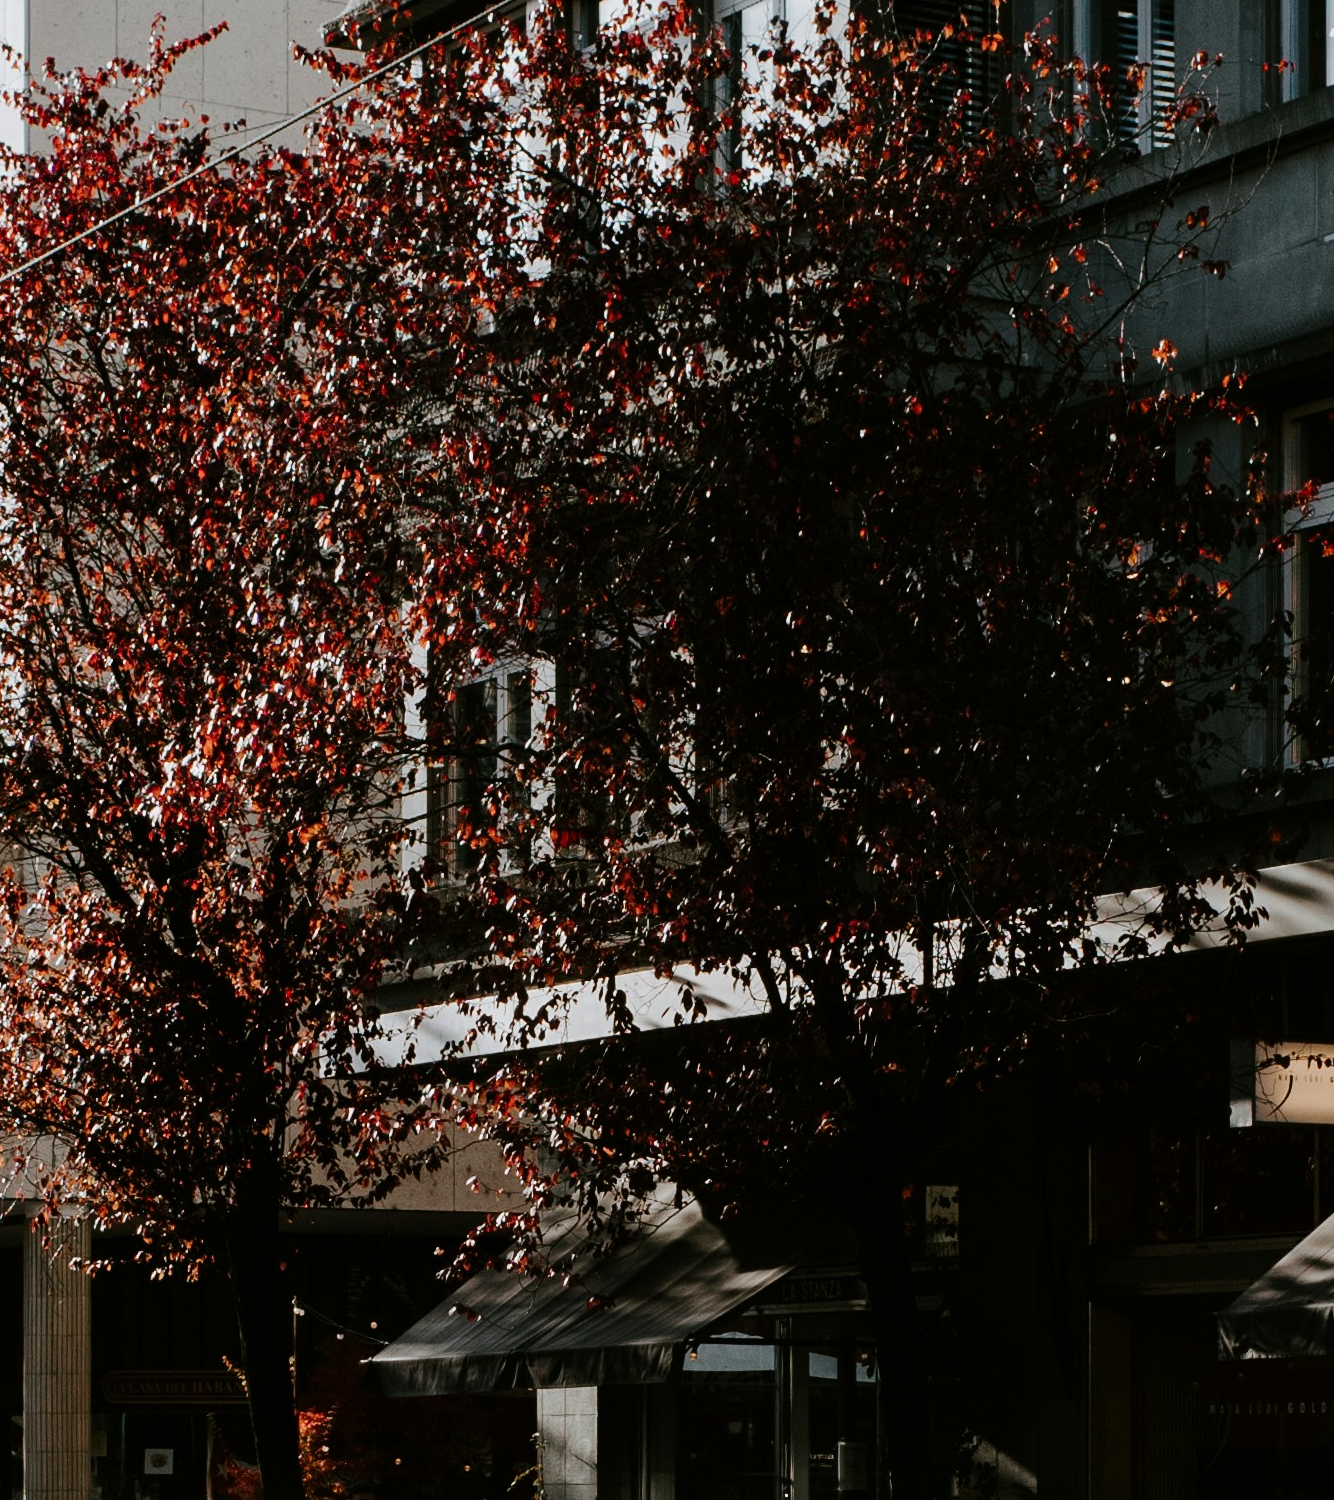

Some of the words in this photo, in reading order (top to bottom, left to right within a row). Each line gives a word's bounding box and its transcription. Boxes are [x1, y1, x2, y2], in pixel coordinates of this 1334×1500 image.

[782, 1282, 797, 1301] LA
[801, 1279, 843, 1300] STANZA
[129, 1380, 162, 1393] CASA
[165, 1382, 189, 1393] DEL
[192, 1380, 244, 1393] HABAN
